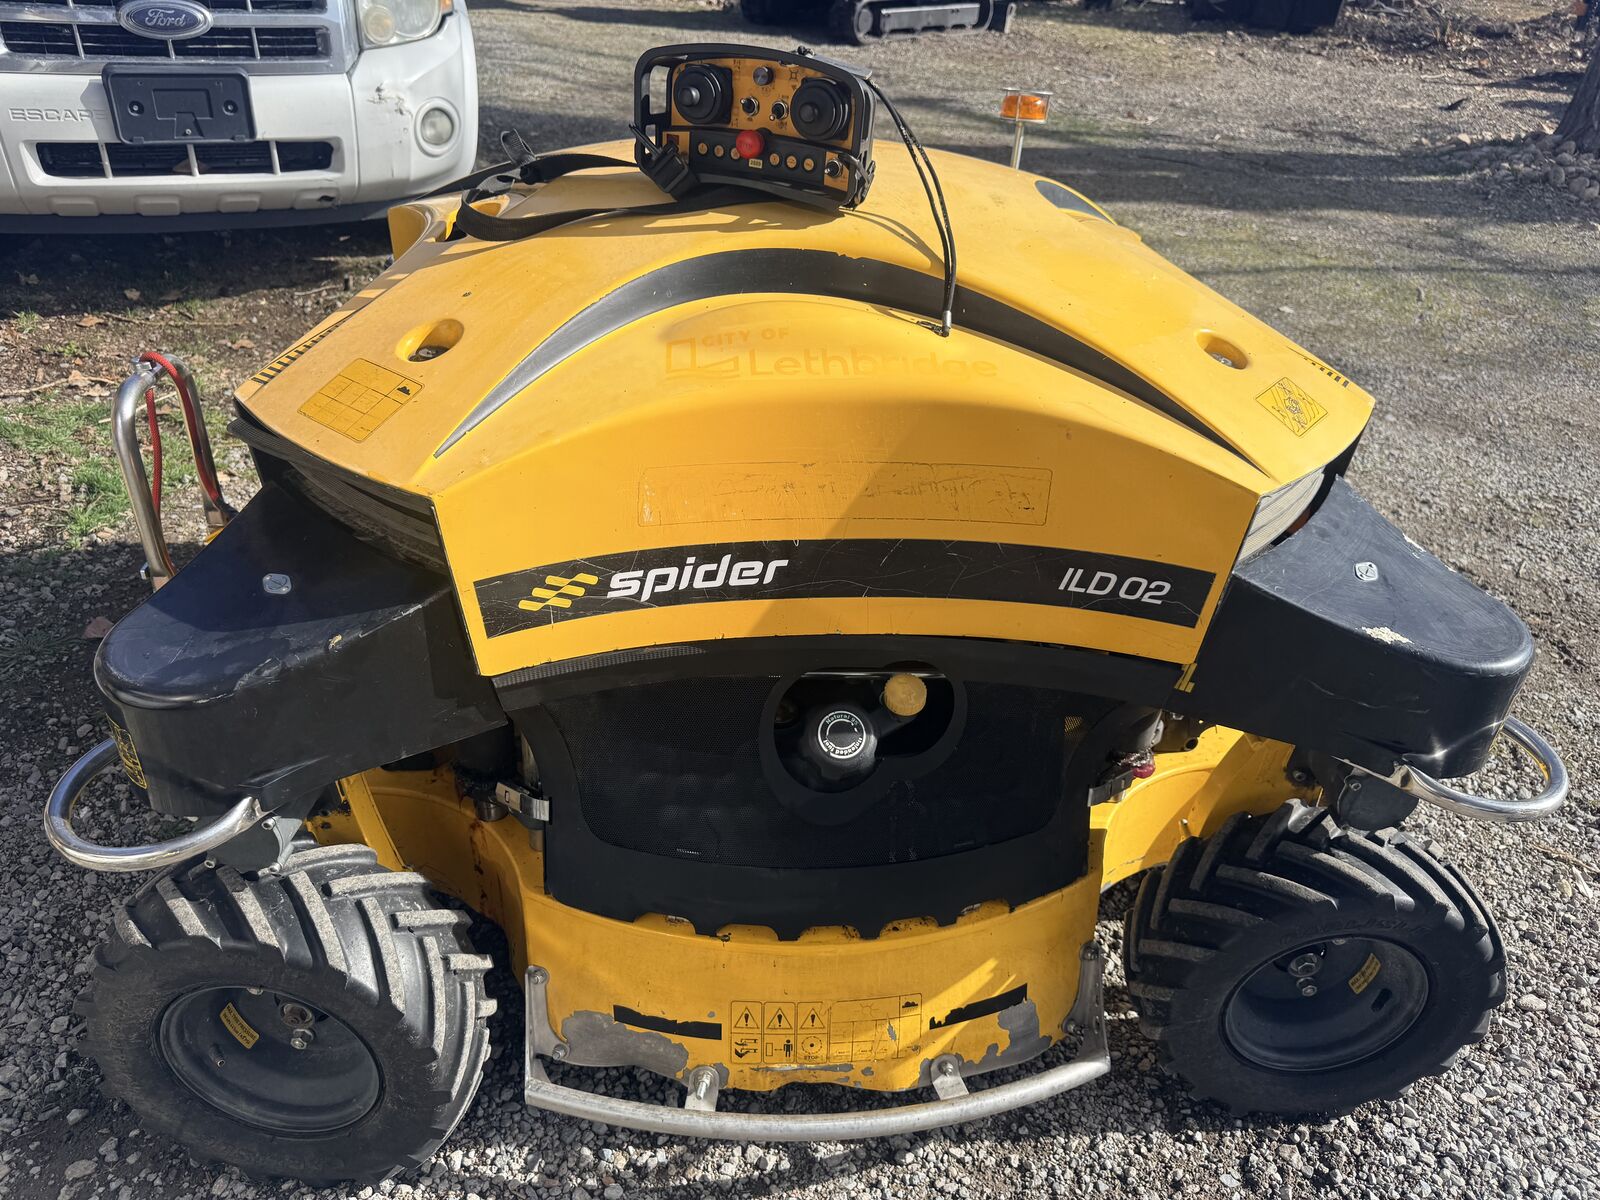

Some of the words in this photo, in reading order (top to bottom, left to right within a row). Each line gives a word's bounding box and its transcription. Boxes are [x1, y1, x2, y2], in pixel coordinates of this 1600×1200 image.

[145, 8, 186, 28] Ford
[8, 107, 105, 122] ESCAPE
[702, 329, 750, 348] CITY
[761, 327, 790, 341] OF
[750, 347, 998, 378] Lethbridge
[607, 554, 789, 602] spider
[1058, 567, 1117, 596] ILD
[1119, 576, 1171, 605] 02
[825, 714, 850, 725] Natural
